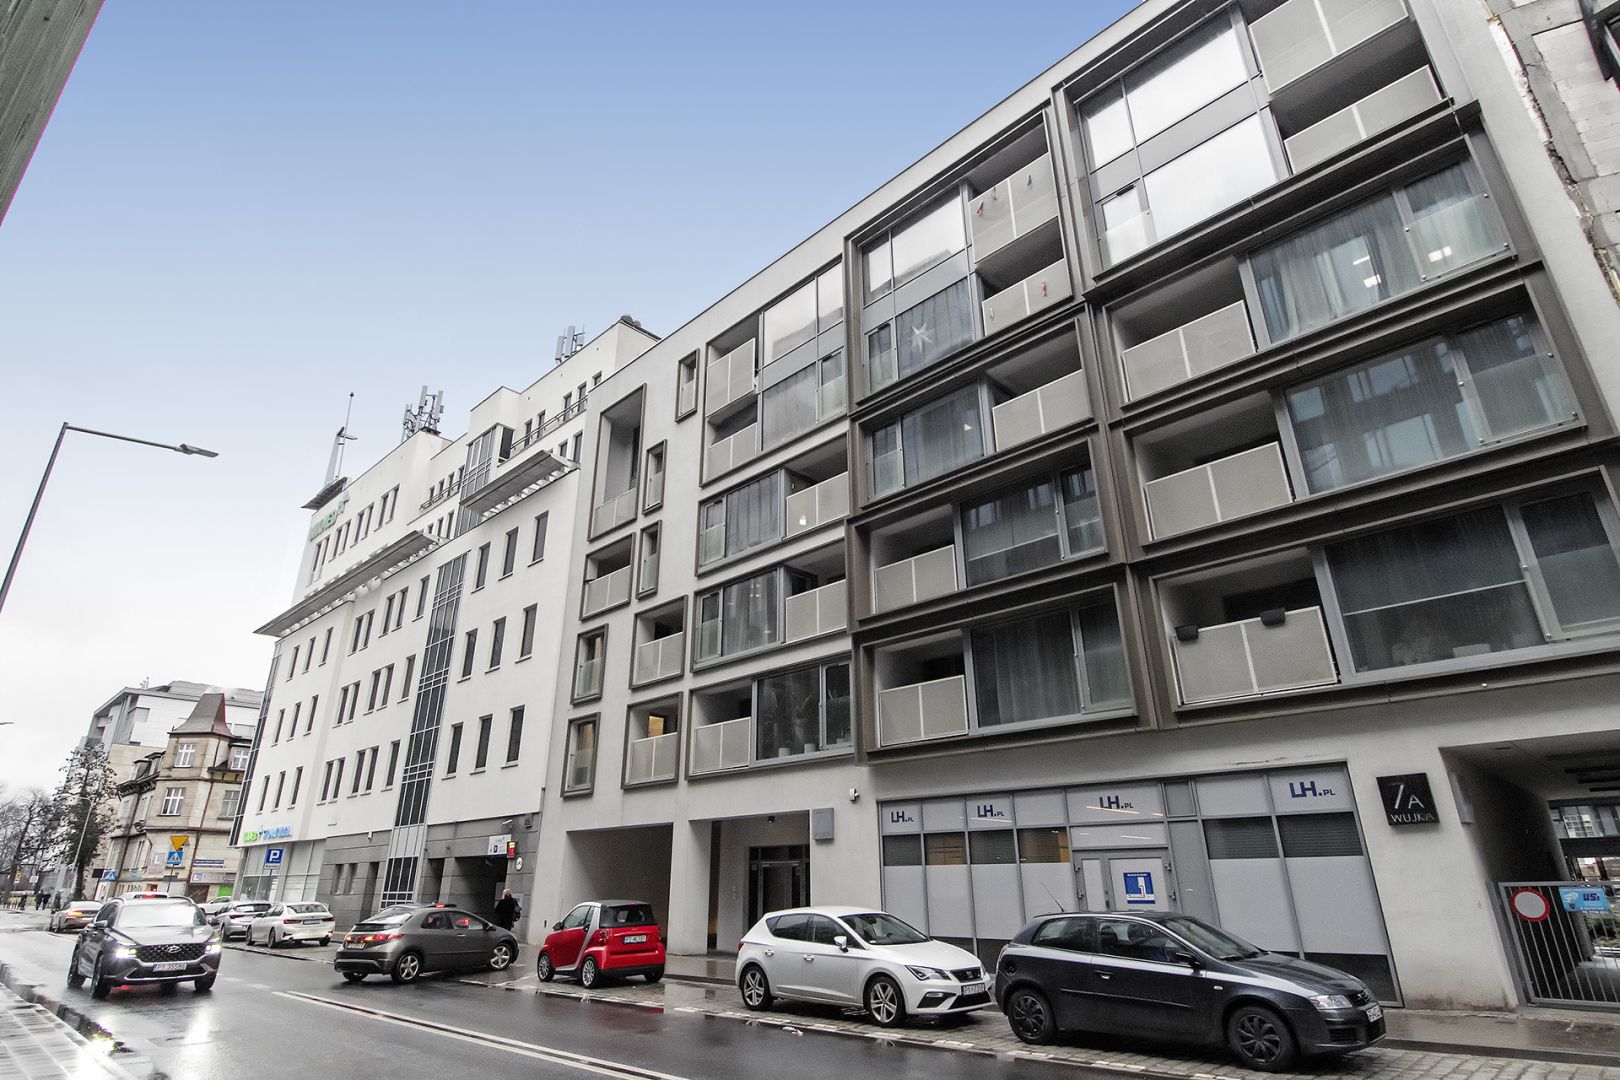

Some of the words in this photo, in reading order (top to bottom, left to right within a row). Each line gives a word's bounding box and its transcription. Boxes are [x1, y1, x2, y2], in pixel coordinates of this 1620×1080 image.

[1289, 781, 1336, 798] LH.PL
[1099, 795, 1134, 809] LH.PL
[890, 811, 914, 823] LH.PL
[976, 804, 1004, 818] LH.PL
[1390, 813, 1436, 823] WUJKA
[269, 850, 280, 862] P
